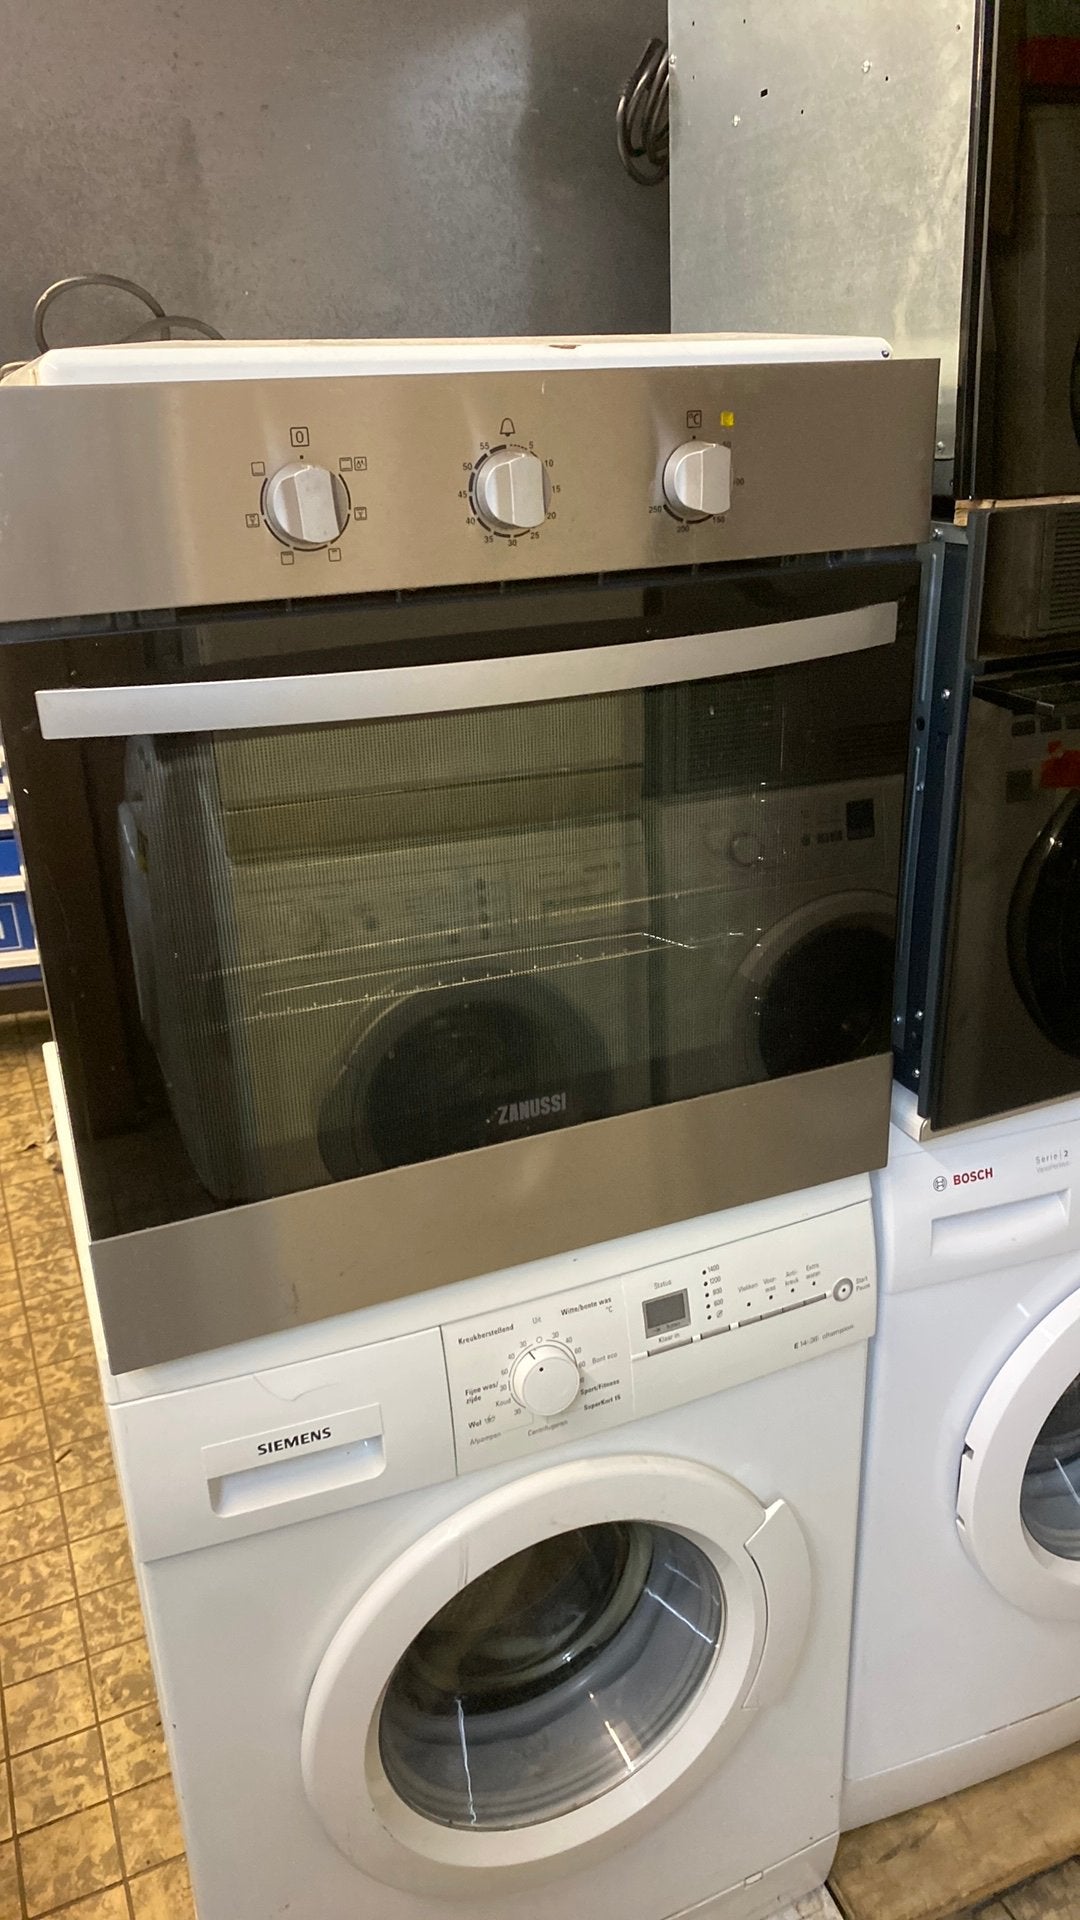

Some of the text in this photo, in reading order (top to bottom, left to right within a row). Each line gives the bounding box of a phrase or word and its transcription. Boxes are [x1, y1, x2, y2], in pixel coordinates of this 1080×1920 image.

[480, 442, 490, 450] 55
[529, 441, 534, 449] 5
[545, 459, 553, 467] 10
[552, 485, 561, 493] 15
[648, 505, 662, 513] 250
[466, 517, 475, 525] 40
[677, 525, 690, 533] 200
[484, 535, 493, 543] 35
[508, 539, 517, 547] 30
[497, 1092, 567, 1125] ZANUSSI
[1035, 1153, 1058, 1165] Serie
[953, 1167, 993, 1186] BOSCH
[708, 1264, 720, 1273] 1400
[709, 1276, 721, 1285] 1200
[856, 1276, 868, 1284] Start
[654, 1280, 672, 1290] Status
[561, 1297, 612, 1316] Witte/bonte was
[532, 1316, 541, 1324] Uit
[458, 1323, 514, 1344] Kreukherstellend
[465, 1387, 481, 1396] Fijne
[468, 1419, 482, 1428] Wol
[257, 1427, 332, 1456] SIEMENS
